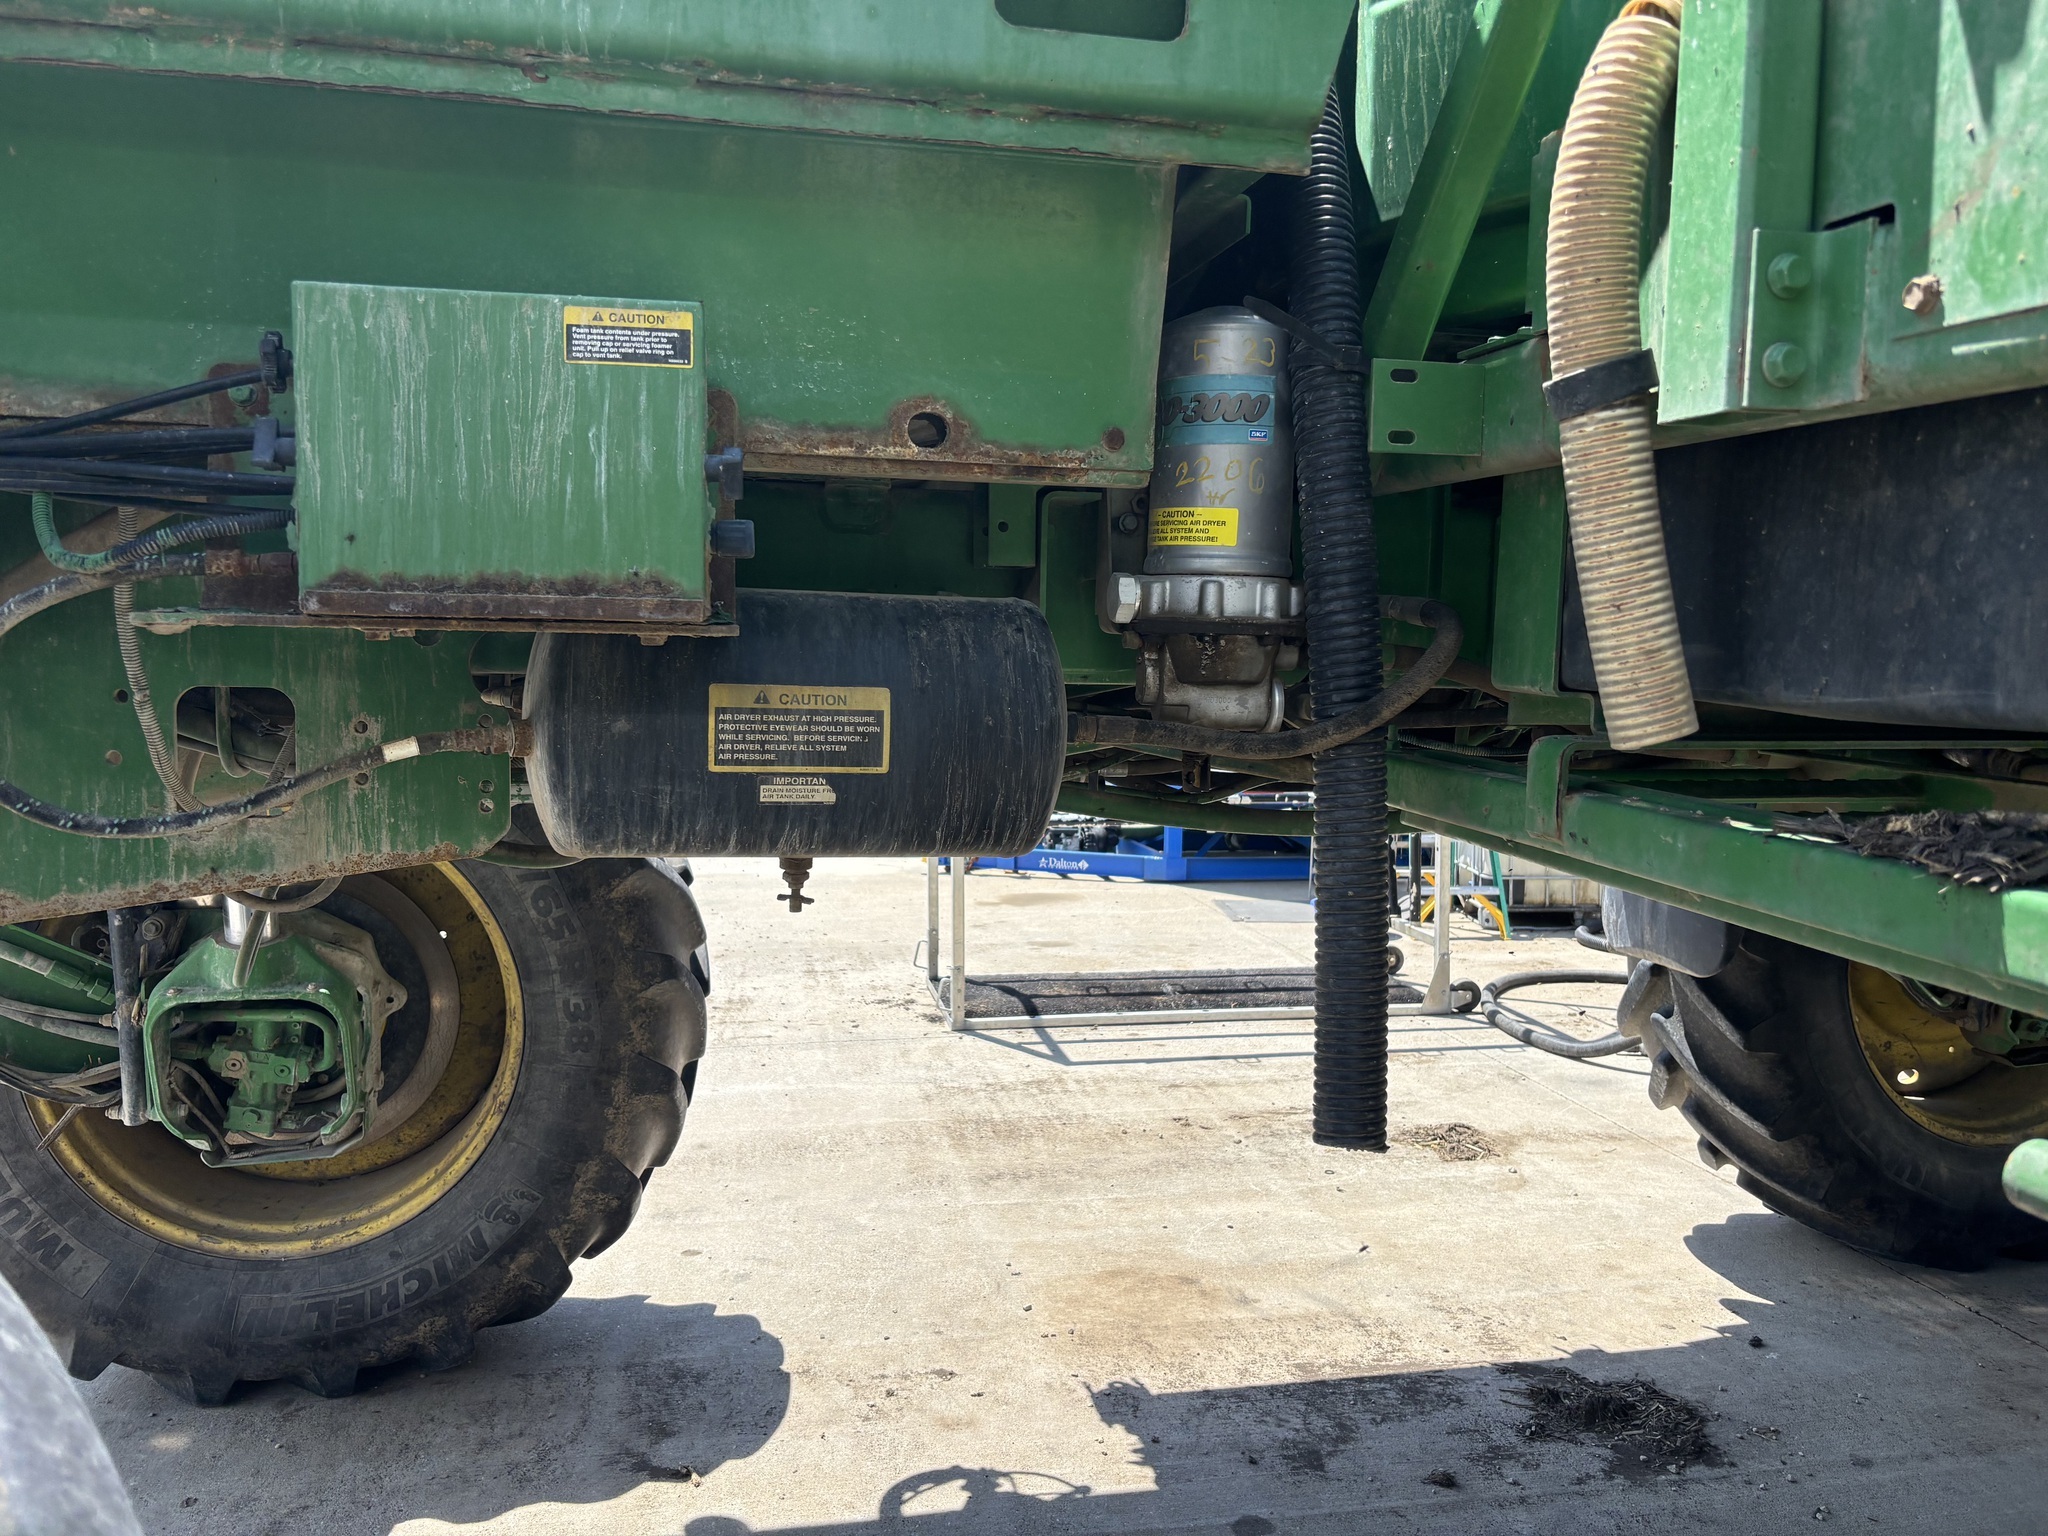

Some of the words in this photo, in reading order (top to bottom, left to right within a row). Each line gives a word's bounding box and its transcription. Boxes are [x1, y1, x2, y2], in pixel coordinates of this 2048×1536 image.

[609, 312, 665, 324] CAUTION
[779, 693, 847, 706] CAUTION
[1049, 857, 1077, 868] Dalton
[238, 1225, 490, 1338] MICHELIN
